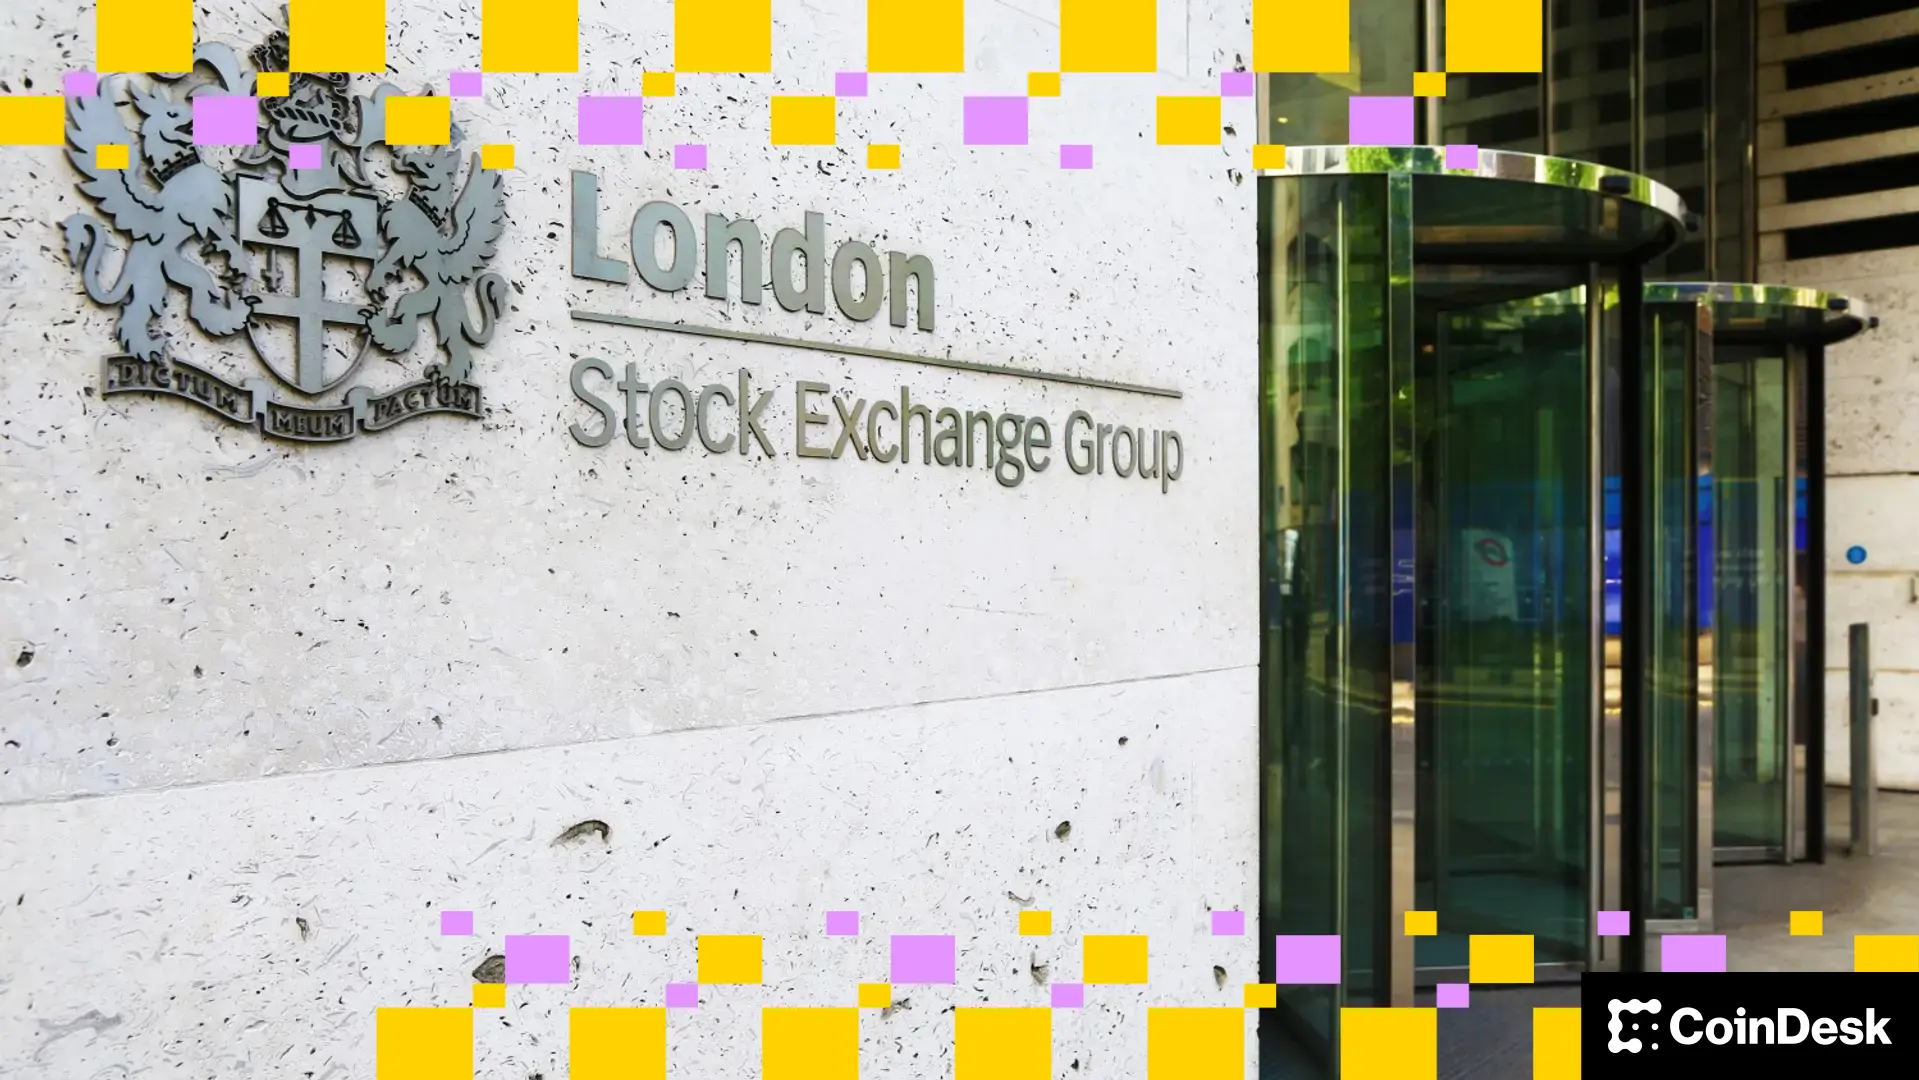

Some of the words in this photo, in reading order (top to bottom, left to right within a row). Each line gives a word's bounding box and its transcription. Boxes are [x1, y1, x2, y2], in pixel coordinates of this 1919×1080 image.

[571, 169, 935, 332] London
[117, 362, 238, 413] DICTUM
[272, 410, 345, 436] MEUM
[569, 356, 775, 458] Stock
[796, 379, 1052, 487] Exchange
[1065, 409, 1183, 494] Group
